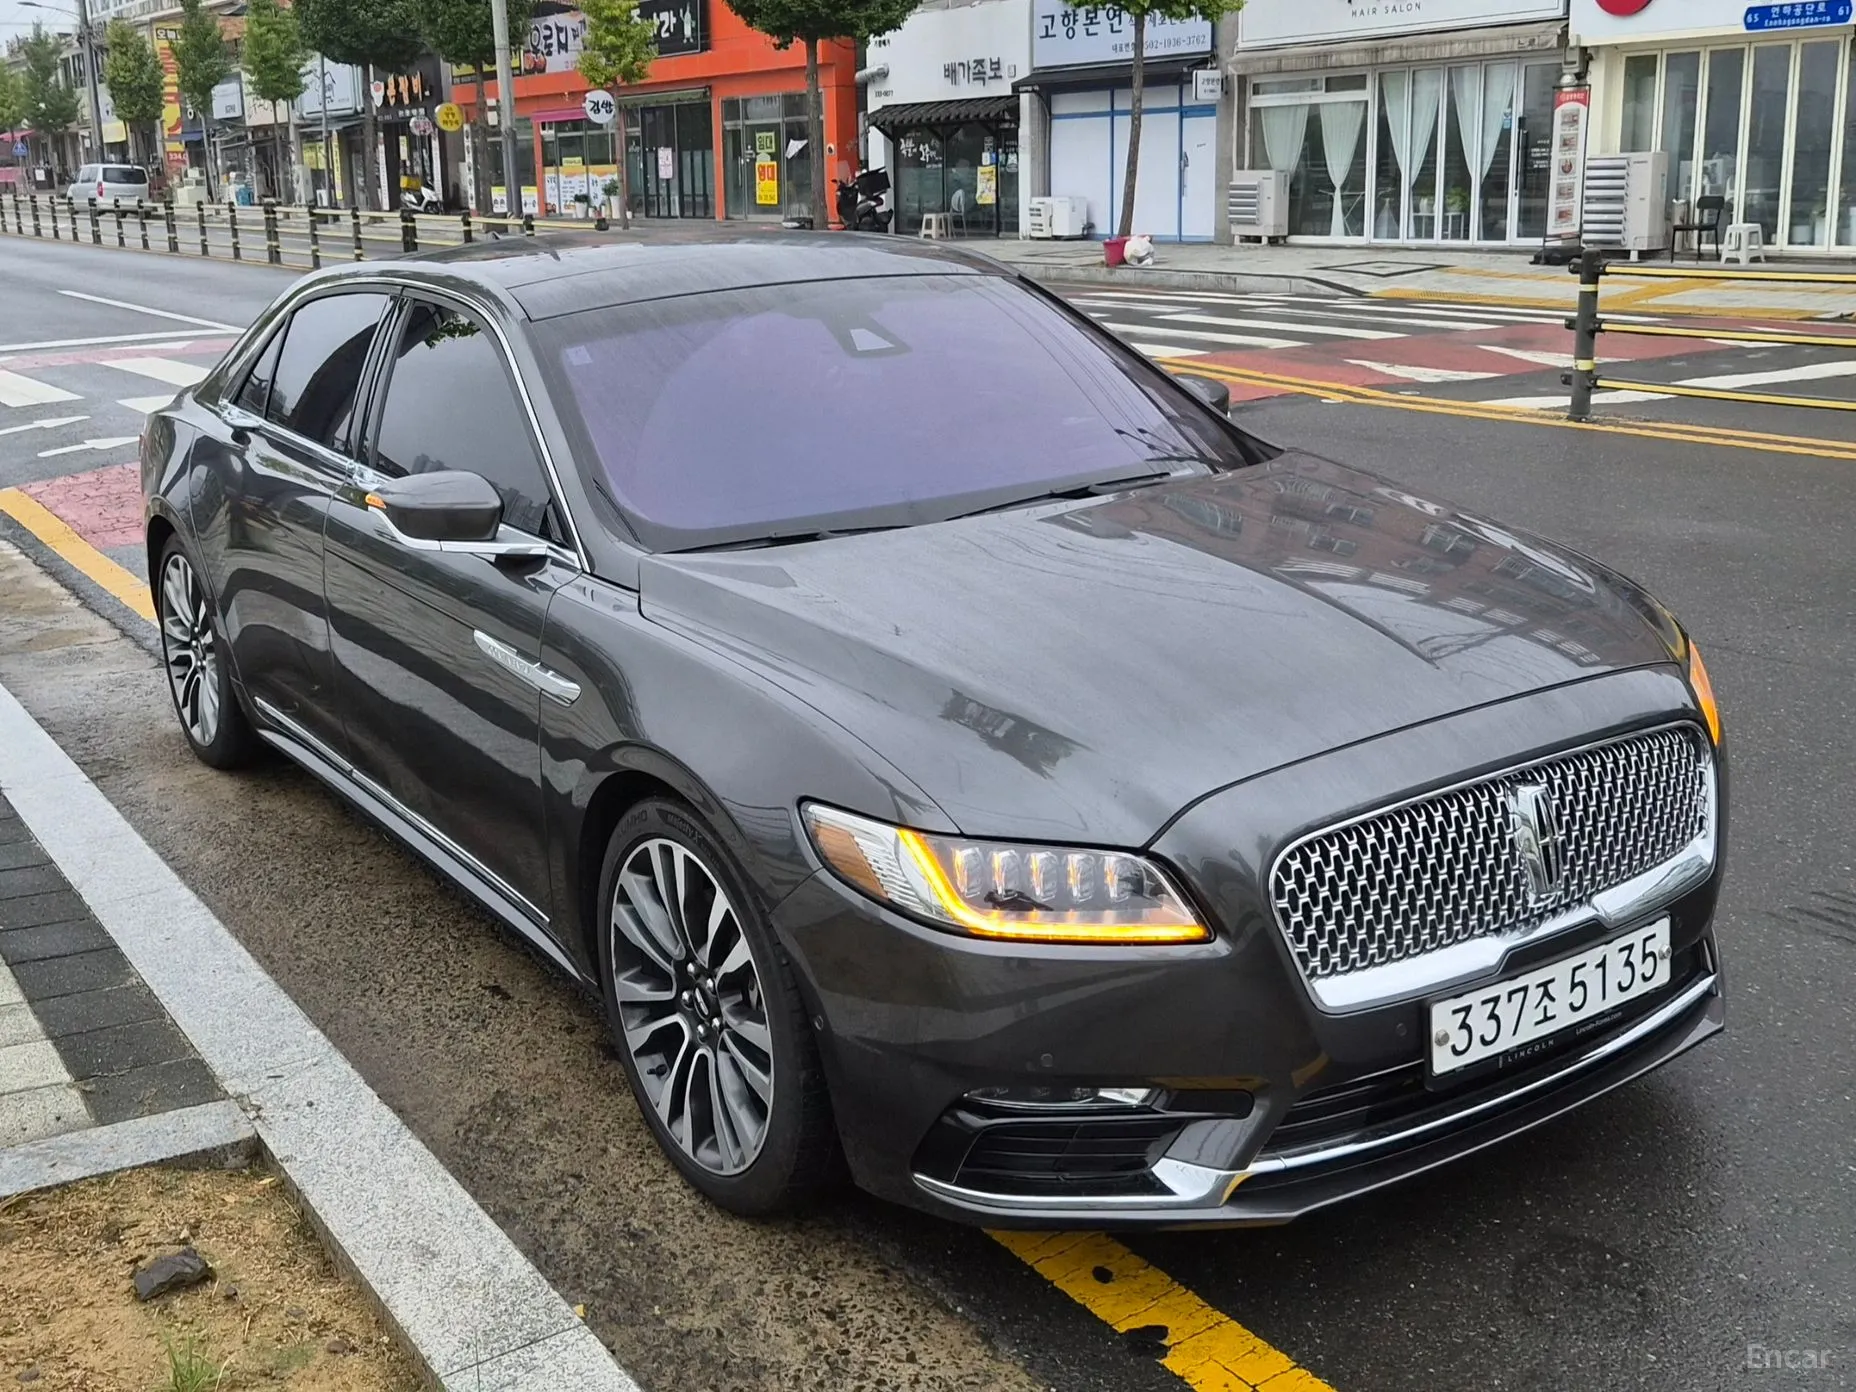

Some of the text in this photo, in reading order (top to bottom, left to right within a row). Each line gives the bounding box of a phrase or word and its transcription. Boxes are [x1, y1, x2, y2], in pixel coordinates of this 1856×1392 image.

[1352, 3, 1421, 19] HAIR SALON
[1746, 13, 1760, 24] 65
[1838, 6, 1850, 16] 61
[1039, 5, 1123, 40] 고향본연
[943, 56, 1003, 87] 배가족보
[587, 99, 614, 114] 김밥
[757, 135, 773, 150] 임대
[758, 164, 775, 182] 임대
[1450, 933, 1658, 1057] 337조 5135
[1507, 1039, 1554, 1063] LINCOLN
